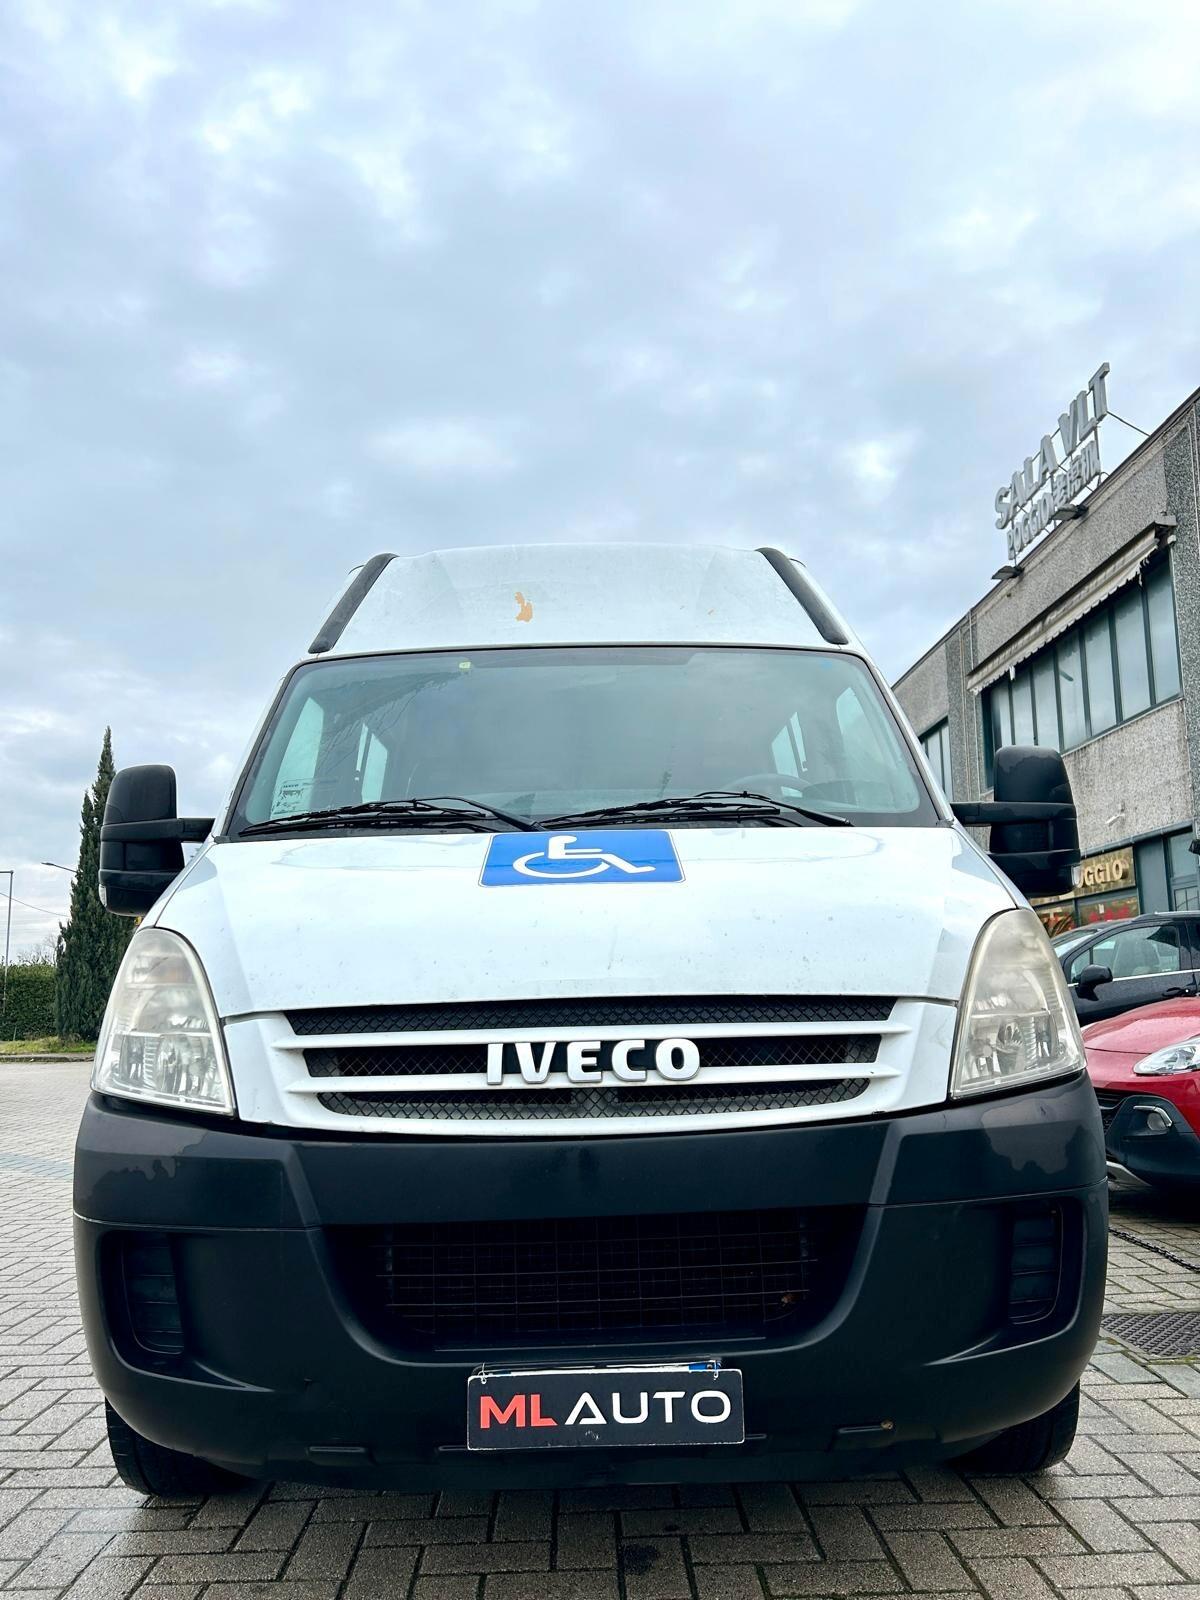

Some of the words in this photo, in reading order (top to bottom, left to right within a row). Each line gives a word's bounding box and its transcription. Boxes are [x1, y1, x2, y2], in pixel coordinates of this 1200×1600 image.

[995, 434, 1058, 530] SALA
[1058, 362, 1110, 456] VLT
[1006, 492, 1055, 560] POGGIO
[487, 1038, 700, 1085] IVECO
[480, 1393, 558, 1429] ML
[565, 1390, 731, 1425] AUTO
